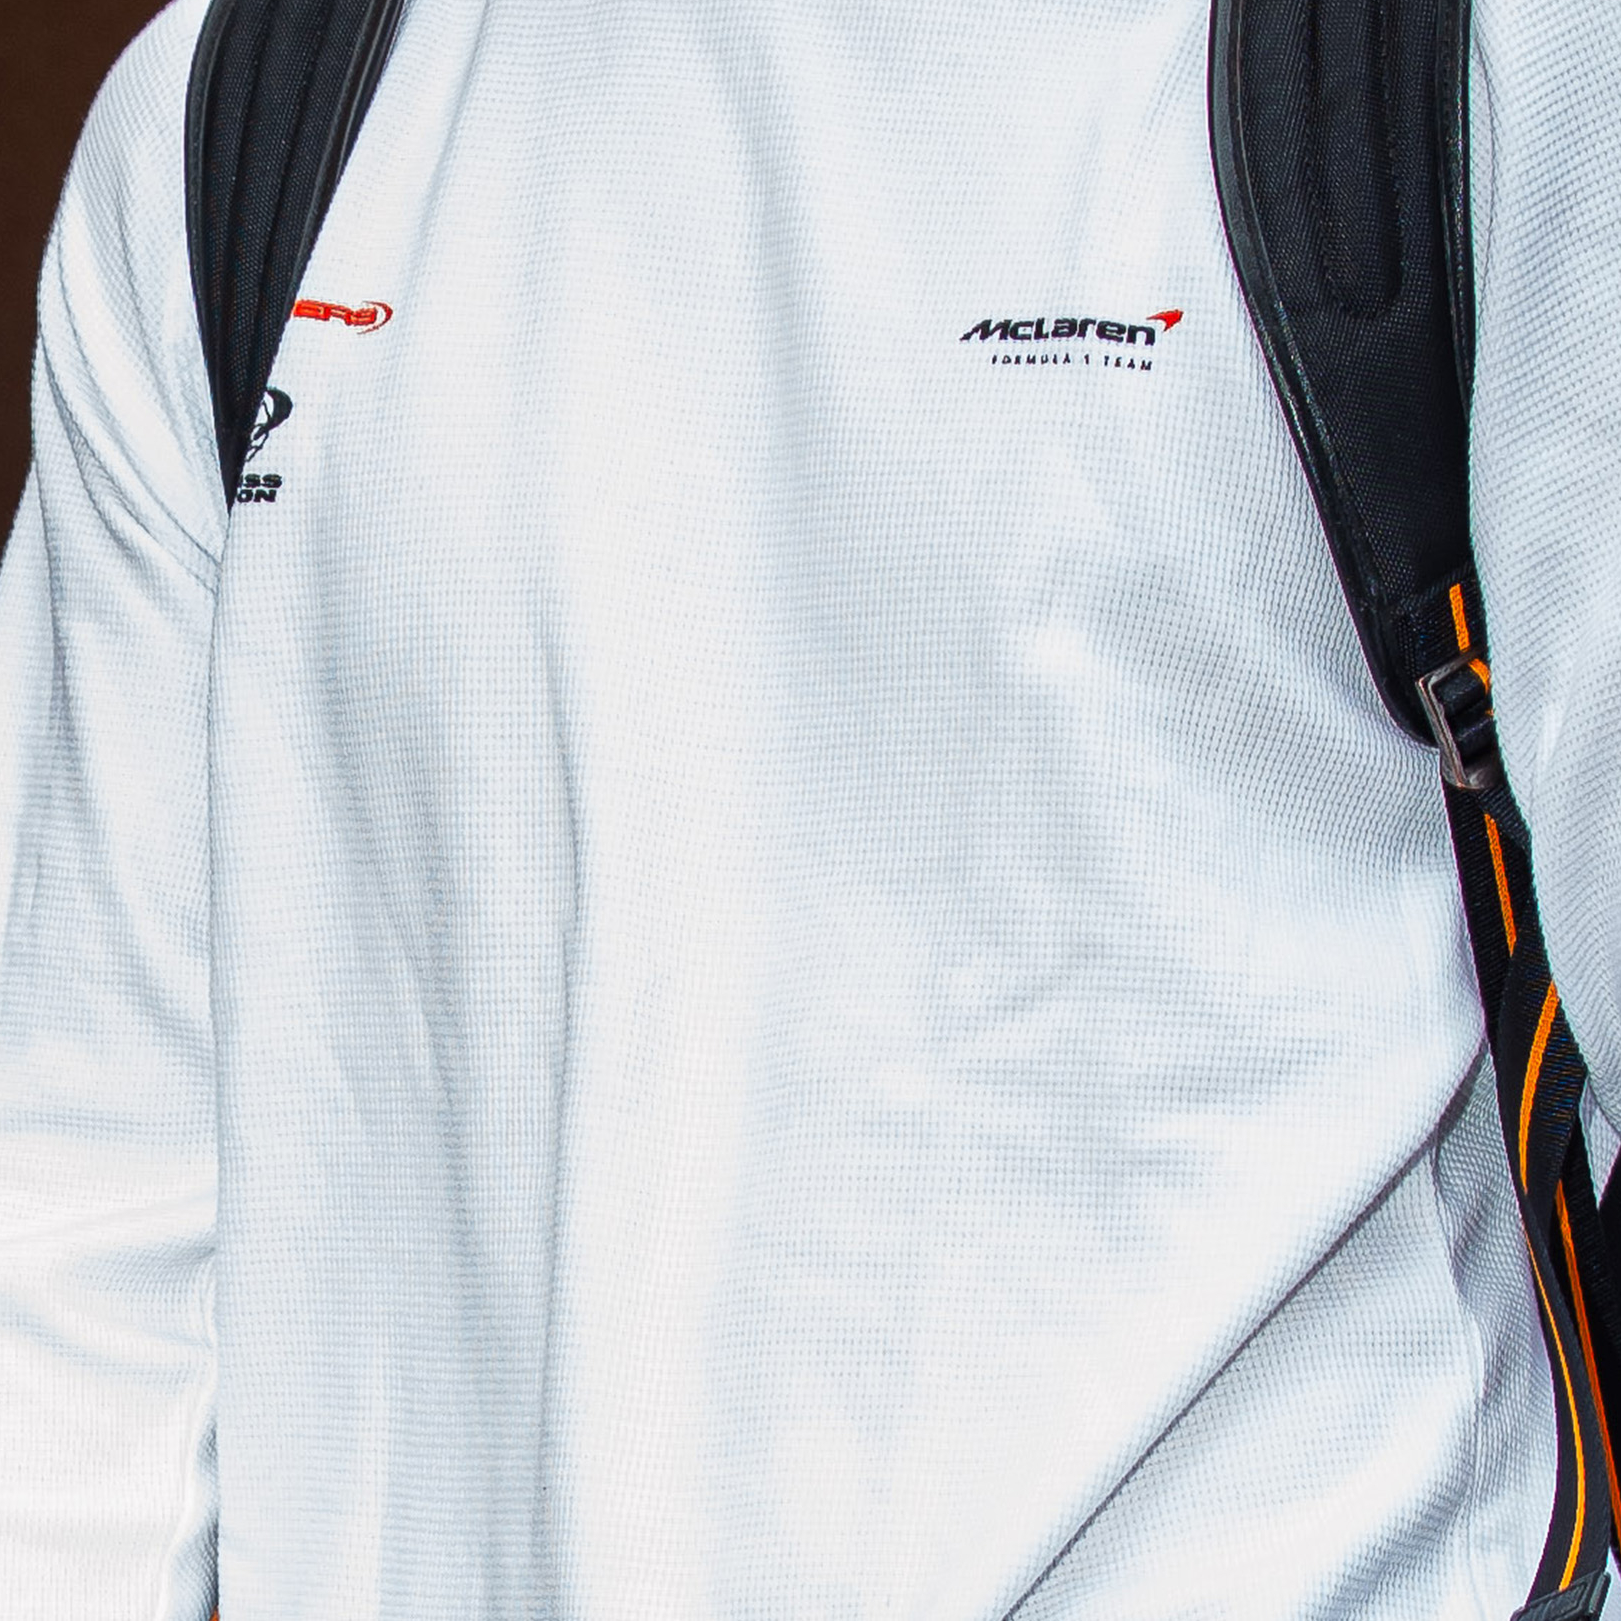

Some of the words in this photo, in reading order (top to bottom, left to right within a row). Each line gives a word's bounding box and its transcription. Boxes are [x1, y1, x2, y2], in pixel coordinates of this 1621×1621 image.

[959, 317, 1156, 346] McLaren
[991, 352, 1071, 366] FORMULA
[1103, 354, 1153, 371] TEAM
[238, 472, 283, 489] SS
